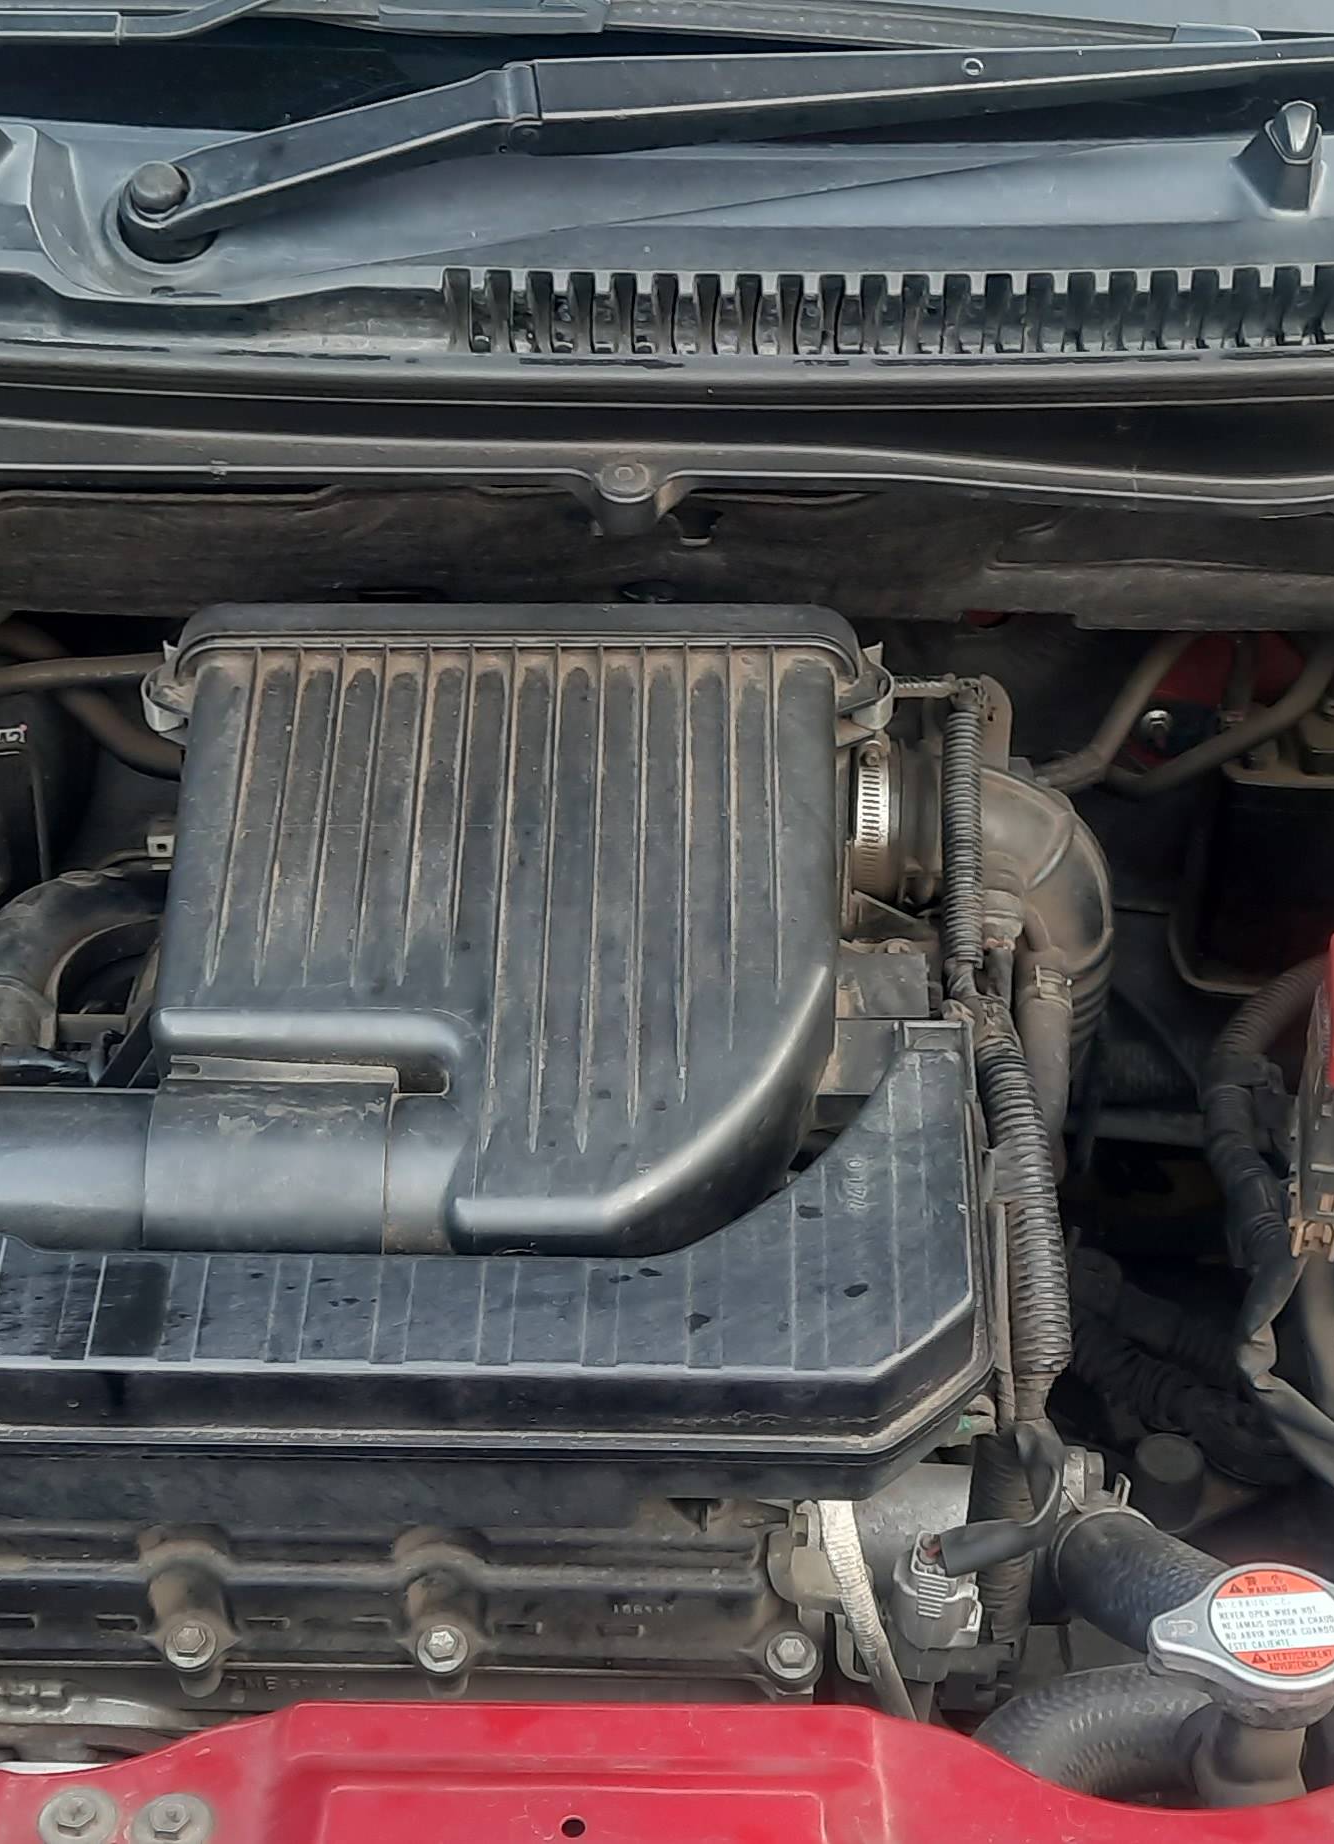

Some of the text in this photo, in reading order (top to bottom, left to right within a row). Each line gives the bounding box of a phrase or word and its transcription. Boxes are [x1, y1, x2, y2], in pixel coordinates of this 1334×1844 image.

[1248, 1584, 1288, 1594] WARNING
[1219, 1611, 1245, 1620] NEVER
[1249, 1610, 1270, 1618] OPEN
